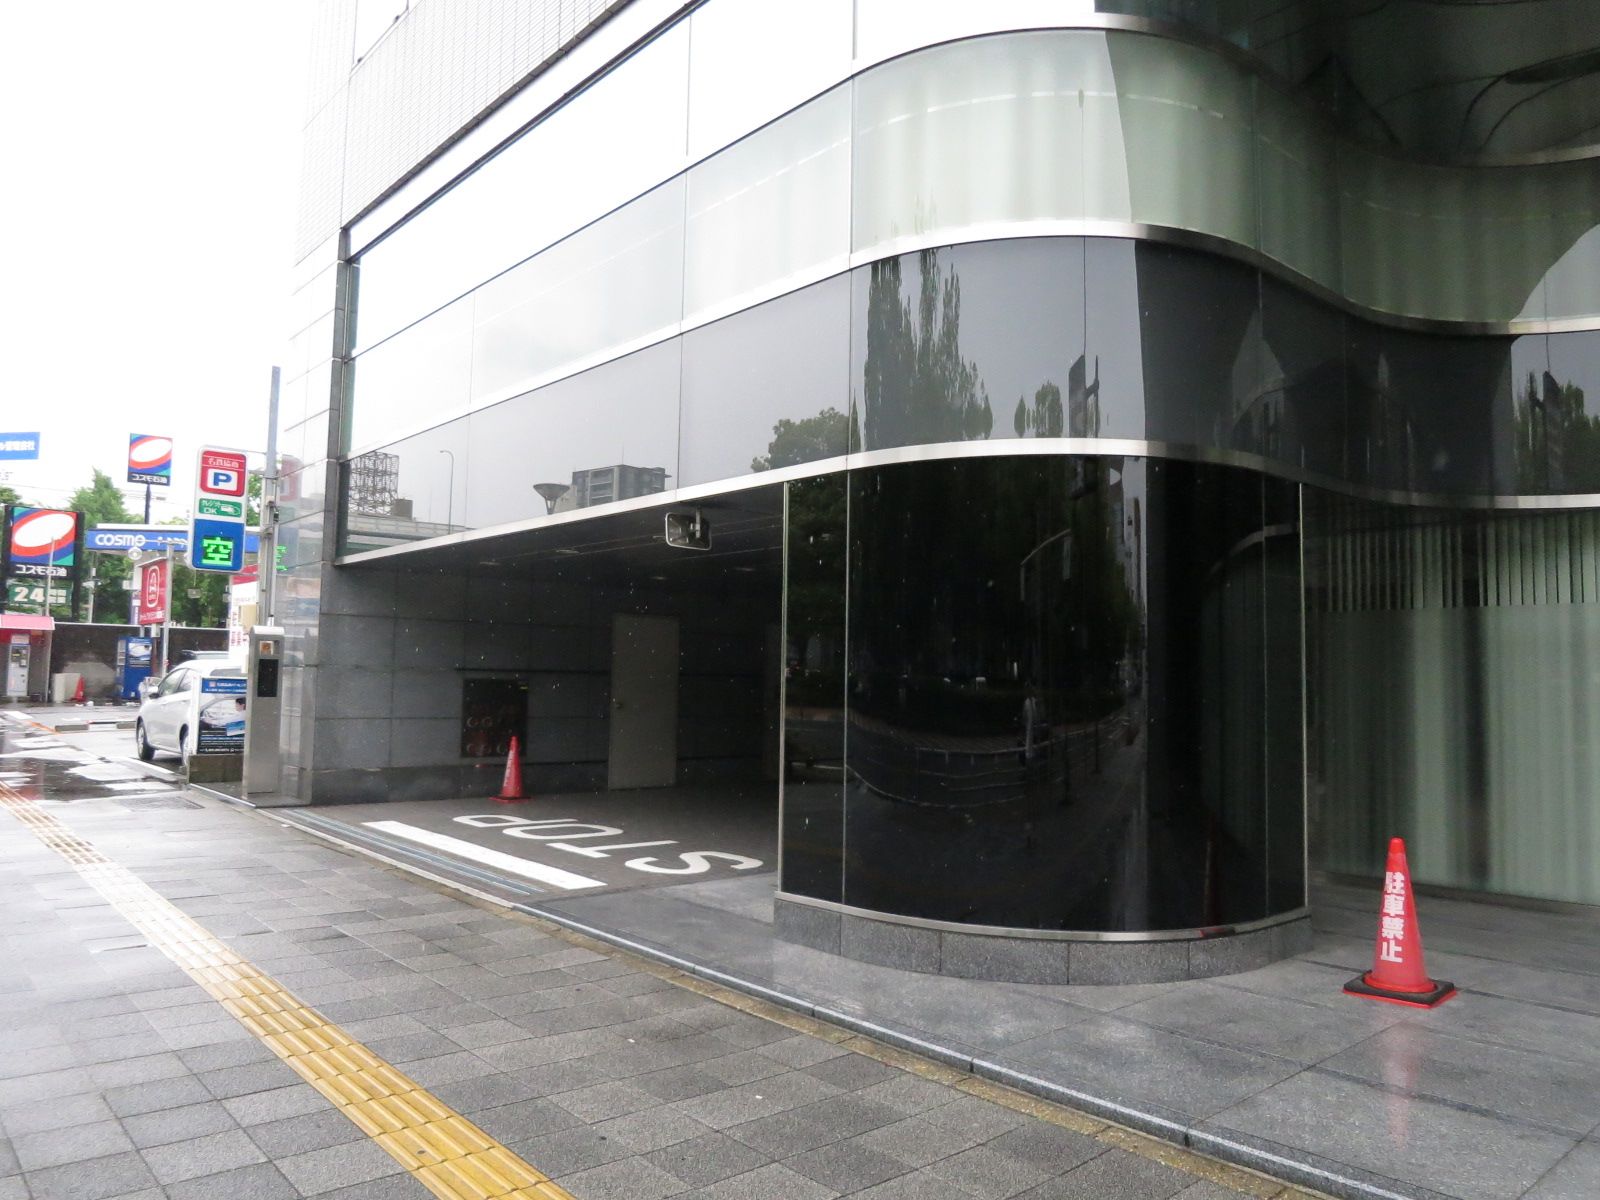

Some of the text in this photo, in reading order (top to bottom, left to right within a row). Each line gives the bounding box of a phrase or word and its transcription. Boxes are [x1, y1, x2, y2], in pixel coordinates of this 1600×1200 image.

[213, 472, 232, 486] P
[95, 534, 146, 547] COSMO
[202, 537, 233, 566] 空
[15, 564, 67, 577] コスモ石油
[14, 587, 45, 602] 24
[452, 814, 764, 875] STOP
[1380, 871, 1405, 963] 駐車禁止
